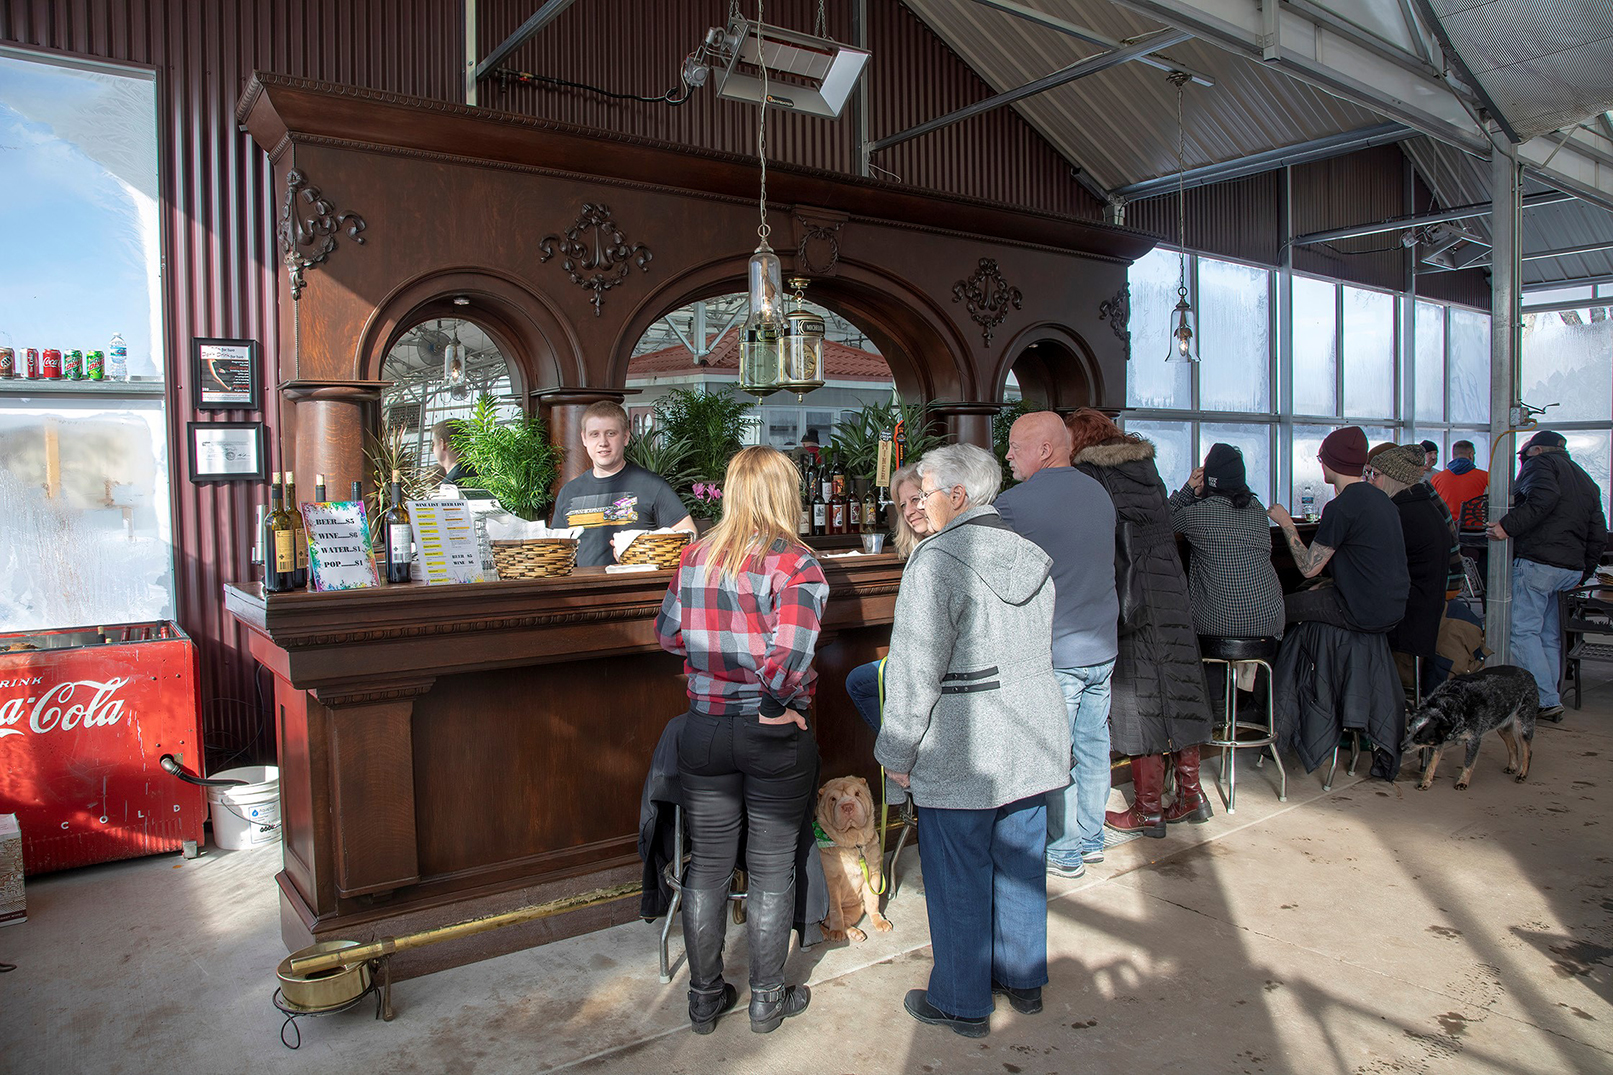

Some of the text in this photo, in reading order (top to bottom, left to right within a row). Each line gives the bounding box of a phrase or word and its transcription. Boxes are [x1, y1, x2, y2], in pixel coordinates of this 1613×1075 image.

[315, 518, 337, 526] BEER
[318, 532, 339, 540] WINE
[321, 546, 350, 554] WATER
[324, 560, 341, 568] POP
[0, 677, 43, 689] RINK
[0, 677, 130, 735] a-Cola
